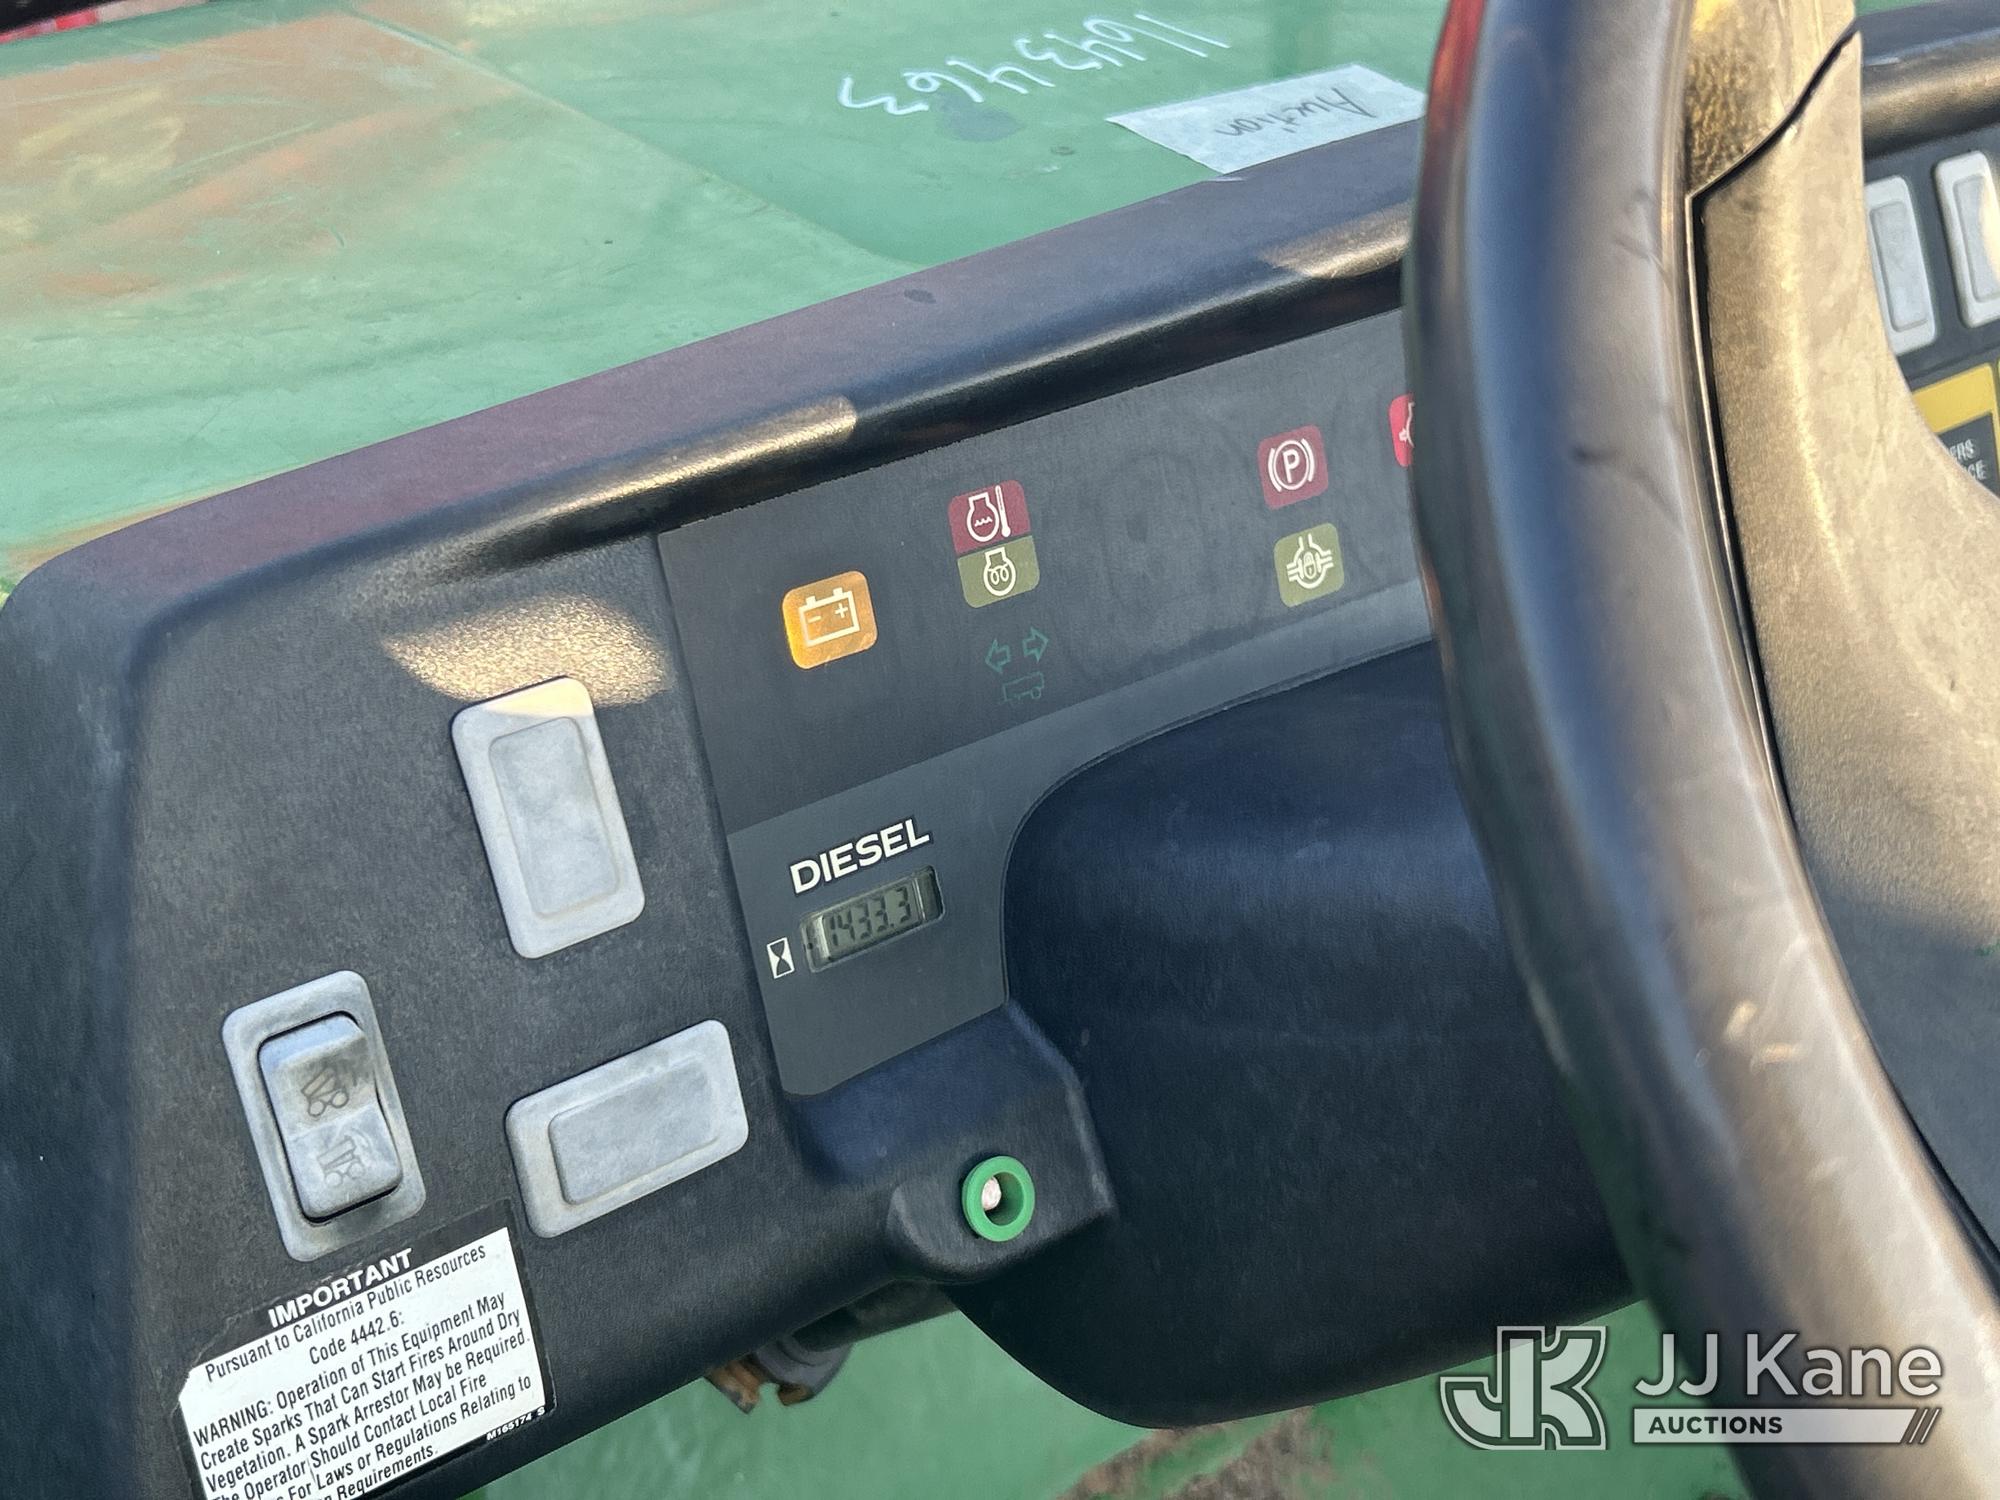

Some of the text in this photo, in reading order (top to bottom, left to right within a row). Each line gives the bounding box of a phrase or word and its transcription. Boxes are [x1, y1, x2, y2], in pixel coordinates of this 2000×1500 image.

[1214, 87, 1377, 138] Auction
[789, 818, 931, 894] DIESEL
[205, 1244, 487, 1383] Pursuant to California Public Resources
[268, 1247, 413, 1328] IMPORTANT
[309, 1311, 405, 1365] Code 4442.6:
[193, 1292, 505, 1447] WARNING: Operation of This Equipment May
[200, 1308, 521, 1471] Create Sparks That Can Start Fires Around Dry
[206, 1328, 531, 1494] Vegetation. A Spark Arrestor May be Required.
[244, 1460, 307, 1500] Operator
[310, 1430, 361, 1468] Should
[363, 1404, 418, 1444] Contact
[419, 1383, 458, 1417] Local
[459, 1373, 487, 1398] Fire
[289, 1375, 532, 1500] For Laws or Regulations Relating to
[336, 1443, 439, 1500] Requirements.
